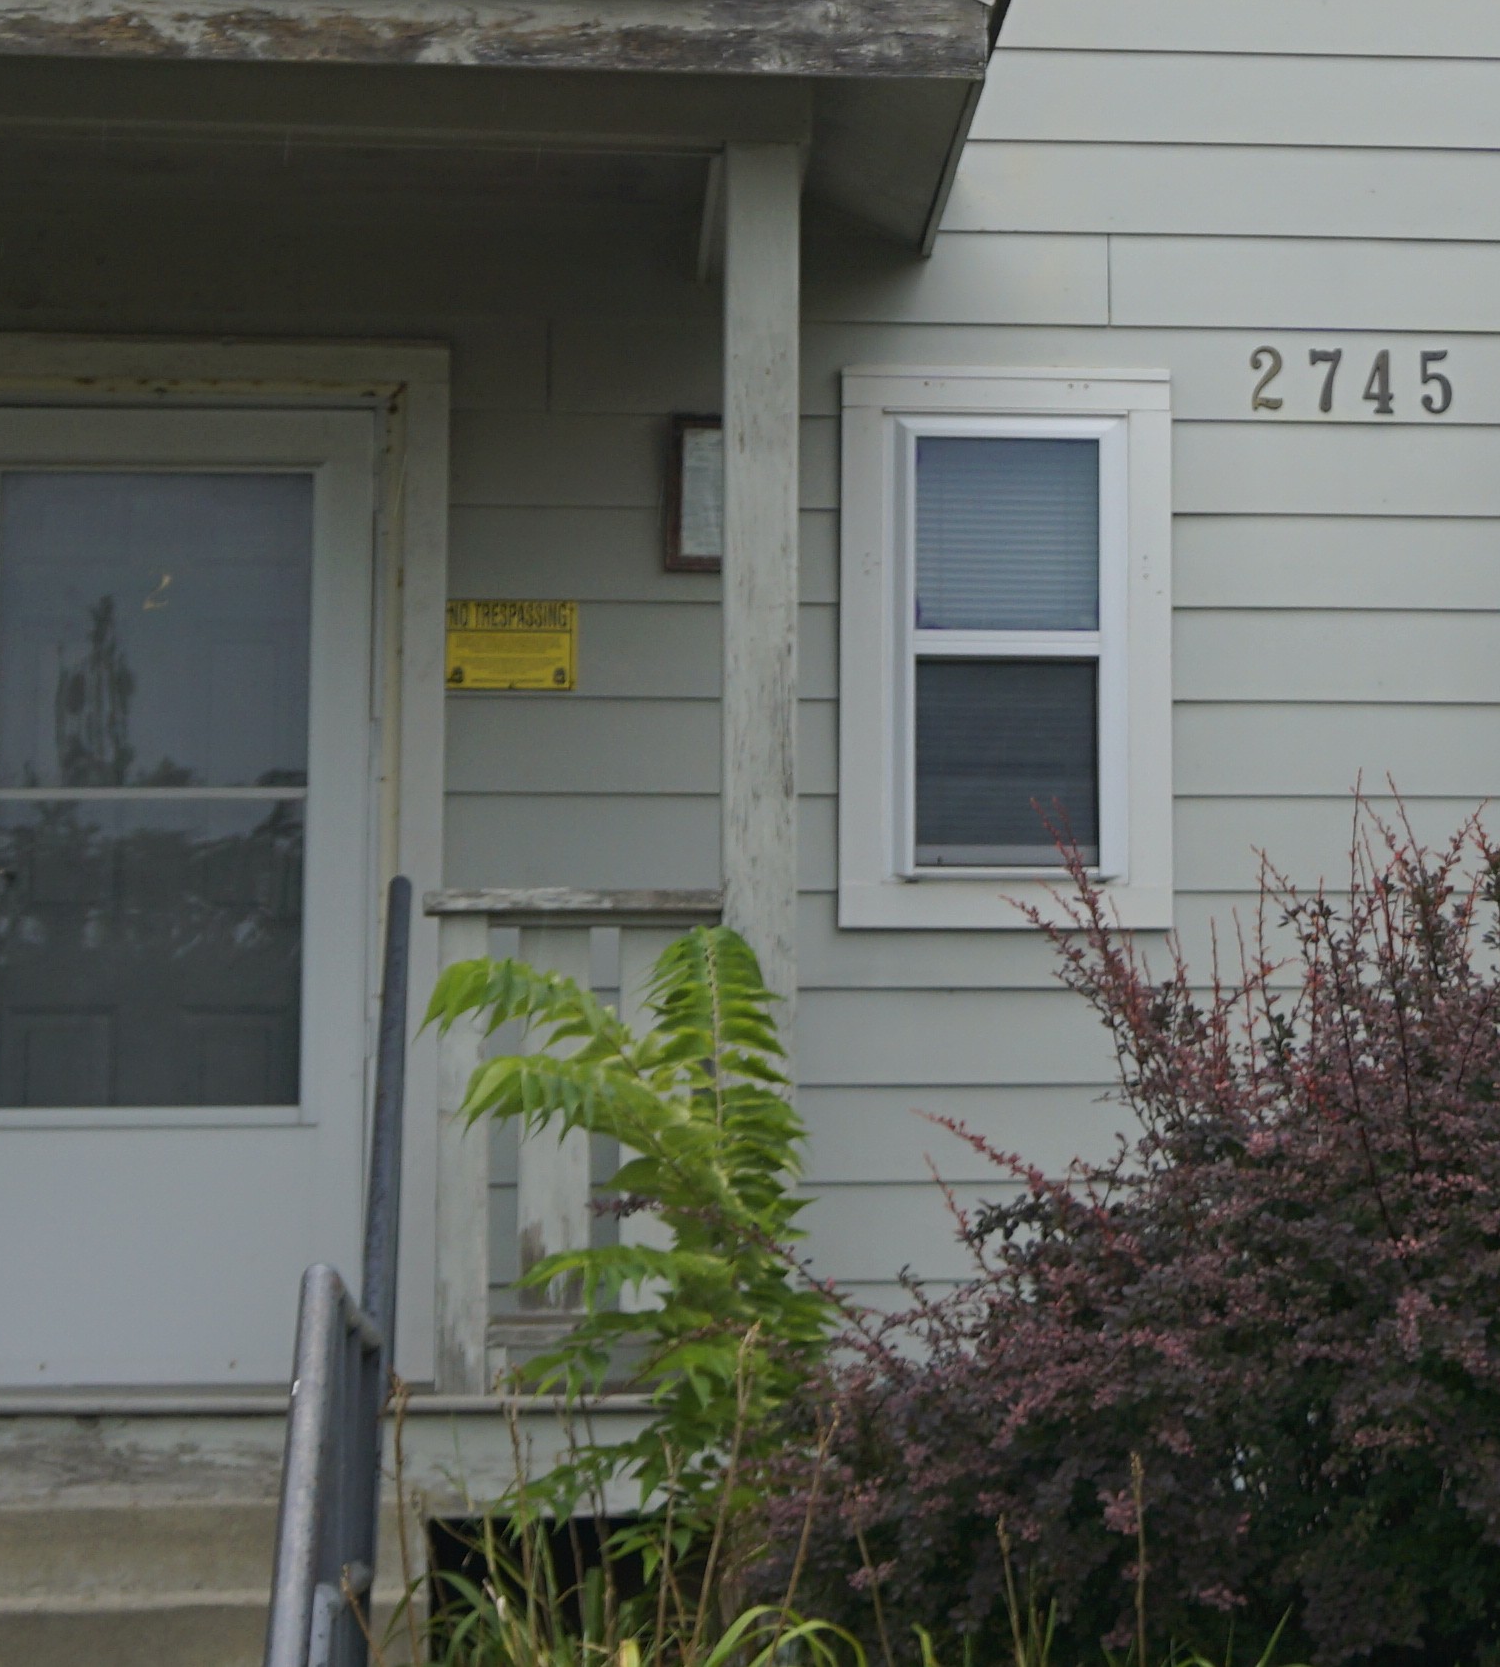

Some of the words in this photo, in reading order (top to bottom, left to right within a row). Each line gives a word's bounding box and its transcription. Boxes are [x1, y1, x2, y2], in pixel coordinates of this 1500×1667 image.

[1250, 345, 1452, 414] 2745
[448, 602, 468, 627] NO
[475, 602, 567, 627] TRESPASSING
